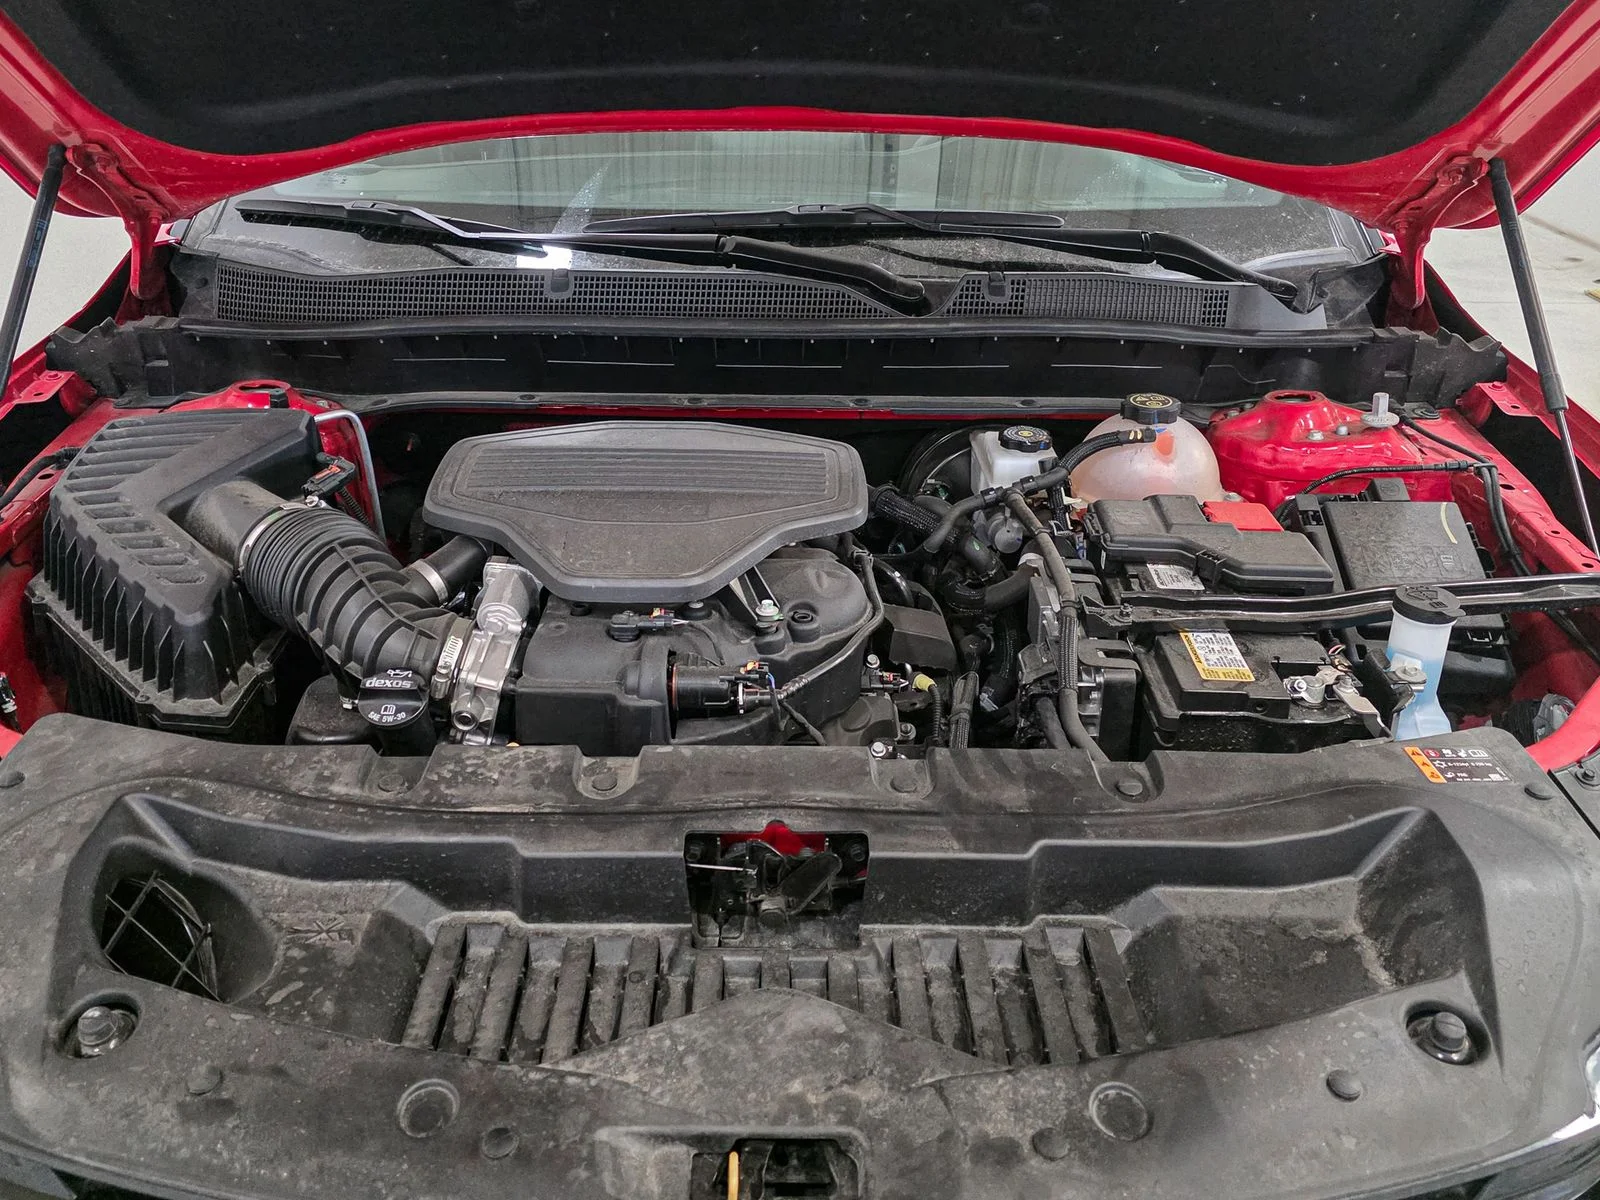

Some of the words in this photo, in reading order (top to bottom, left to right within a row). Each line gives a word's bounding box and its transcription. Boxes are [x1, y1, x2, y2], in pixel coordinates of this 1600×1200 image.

[366, 677, 413, 688] dexos
[368, 711, 381, 721] SAE
[382, 712, 406, 722] 5W-30
